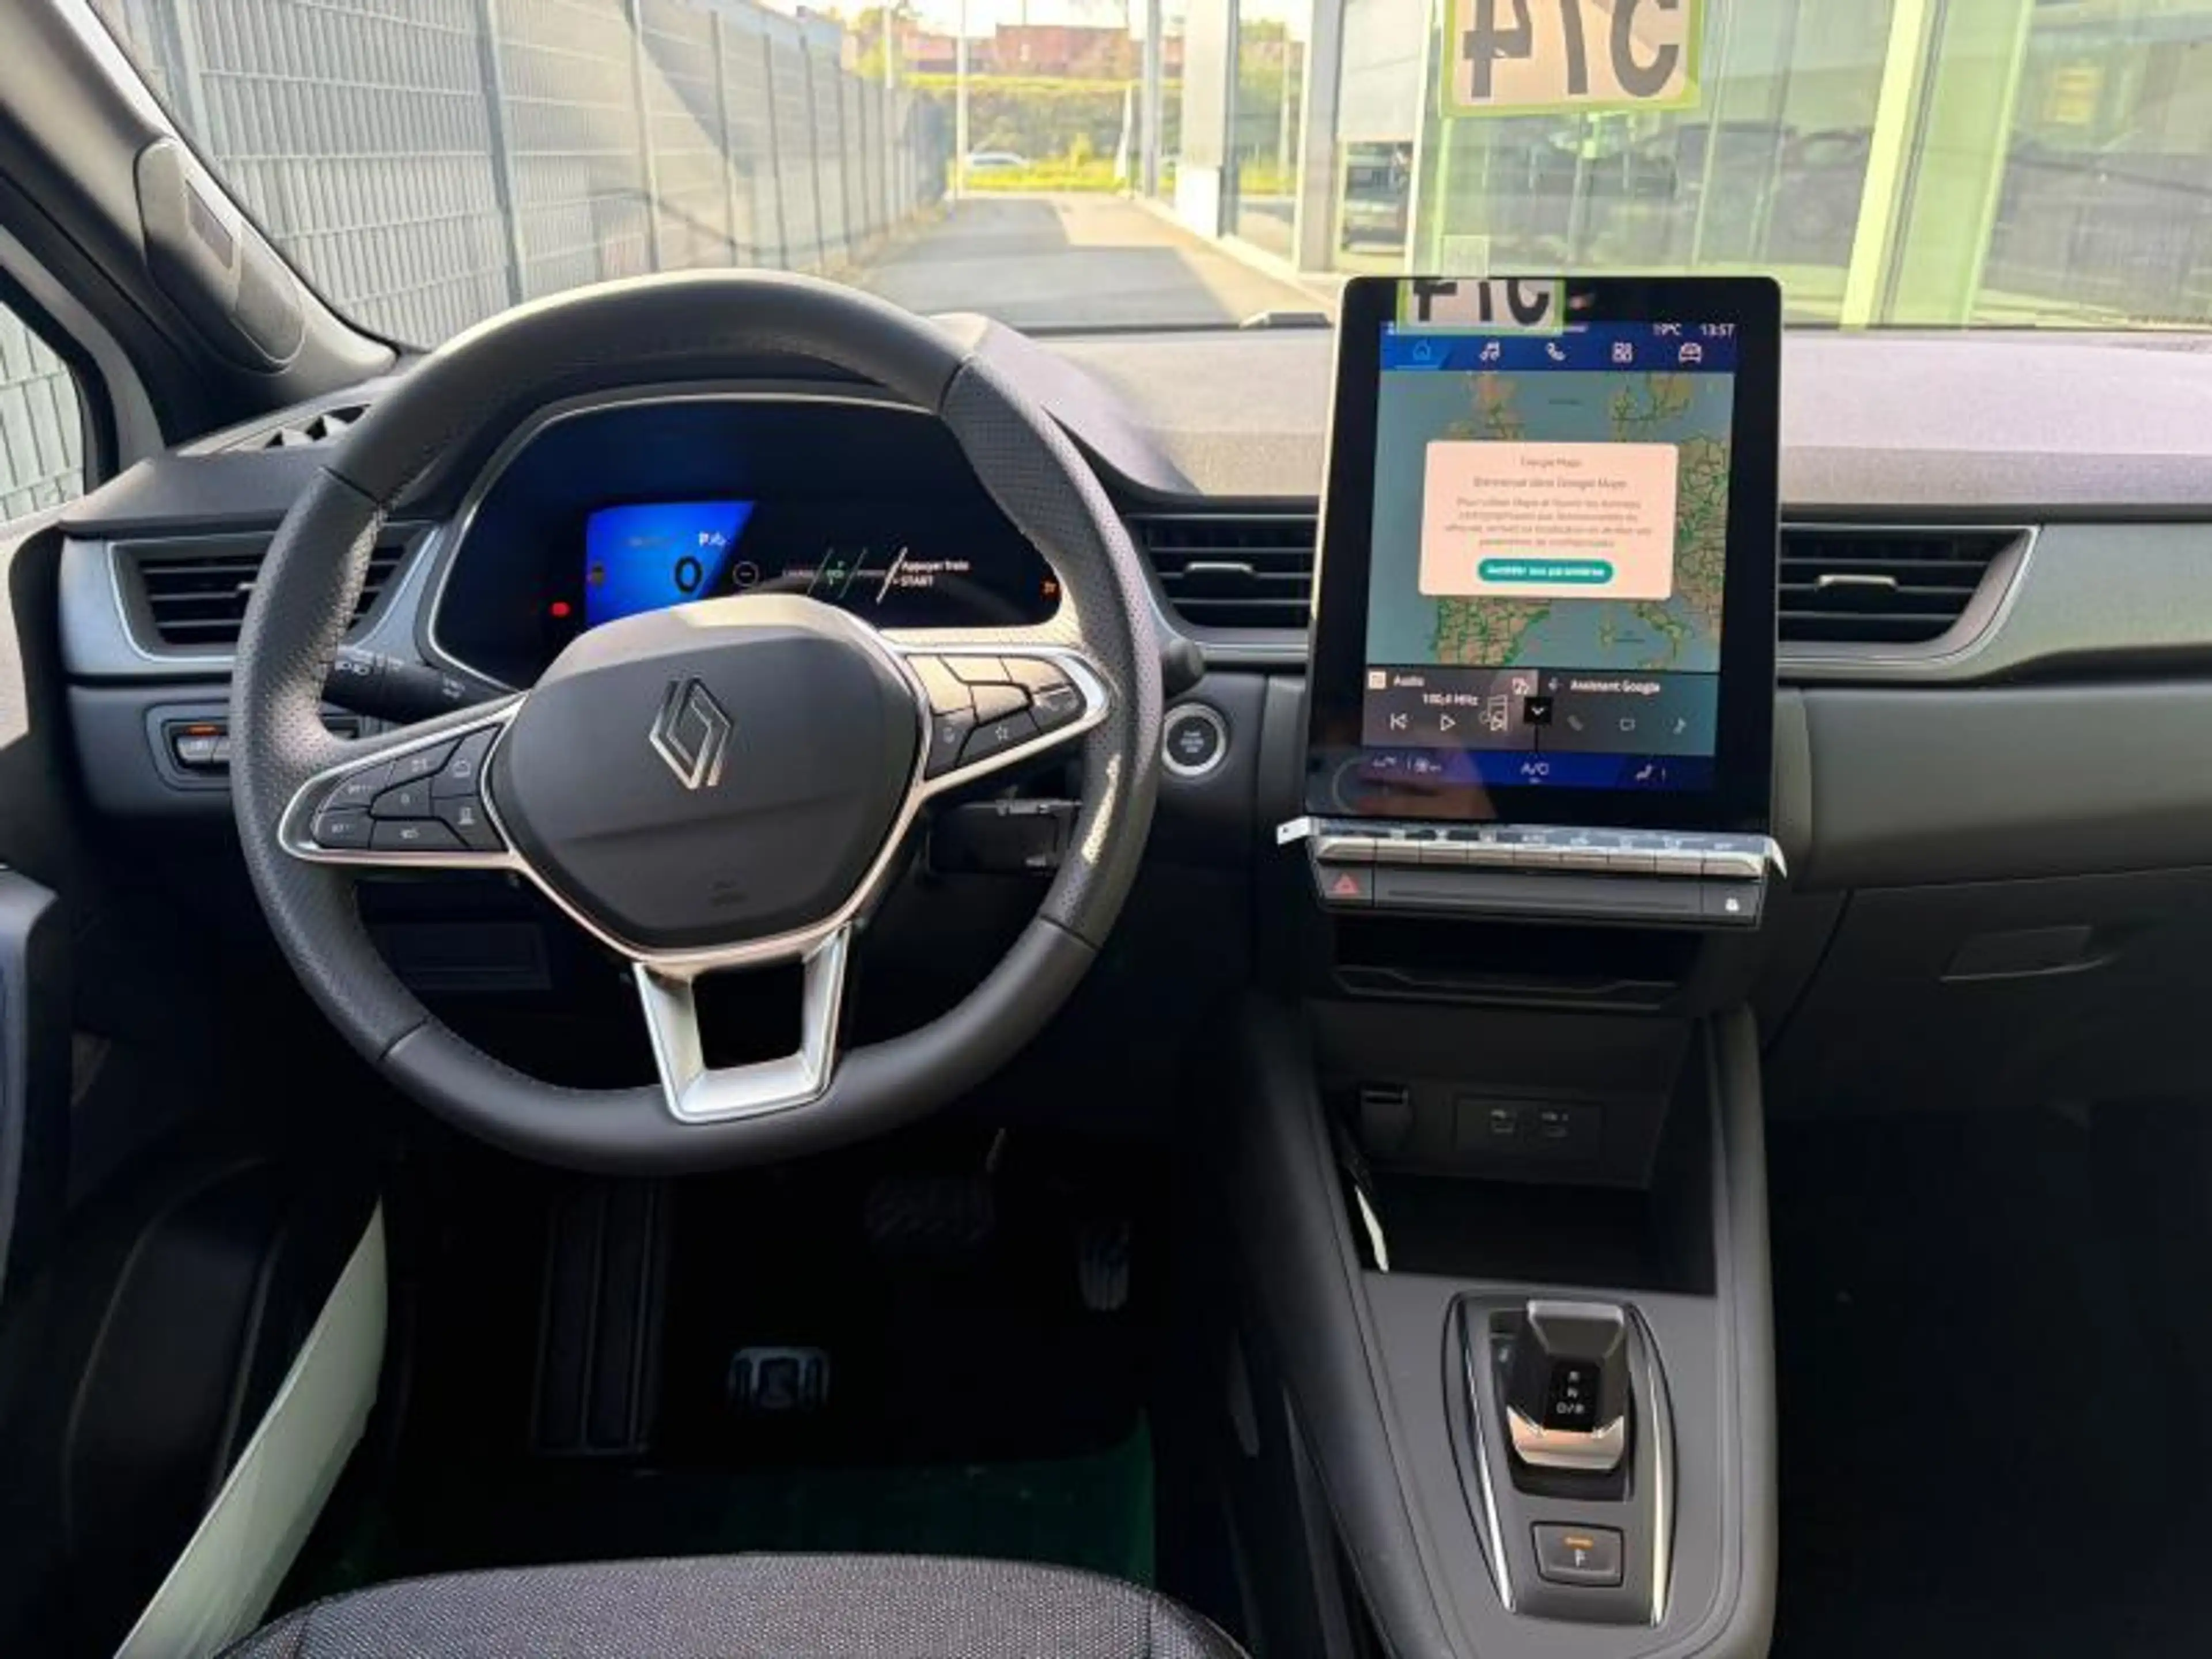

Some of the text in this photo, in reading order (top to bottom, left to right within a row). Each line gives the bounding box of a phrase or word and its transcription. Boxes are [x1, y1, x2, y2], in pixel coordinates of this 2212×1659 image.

[674, 556, 703, 594] 0
[900, 575, 933, 587] START
[1393, 675, 1425, 687] Audio
[1570, 678, 1660, 695] Assistant Google
